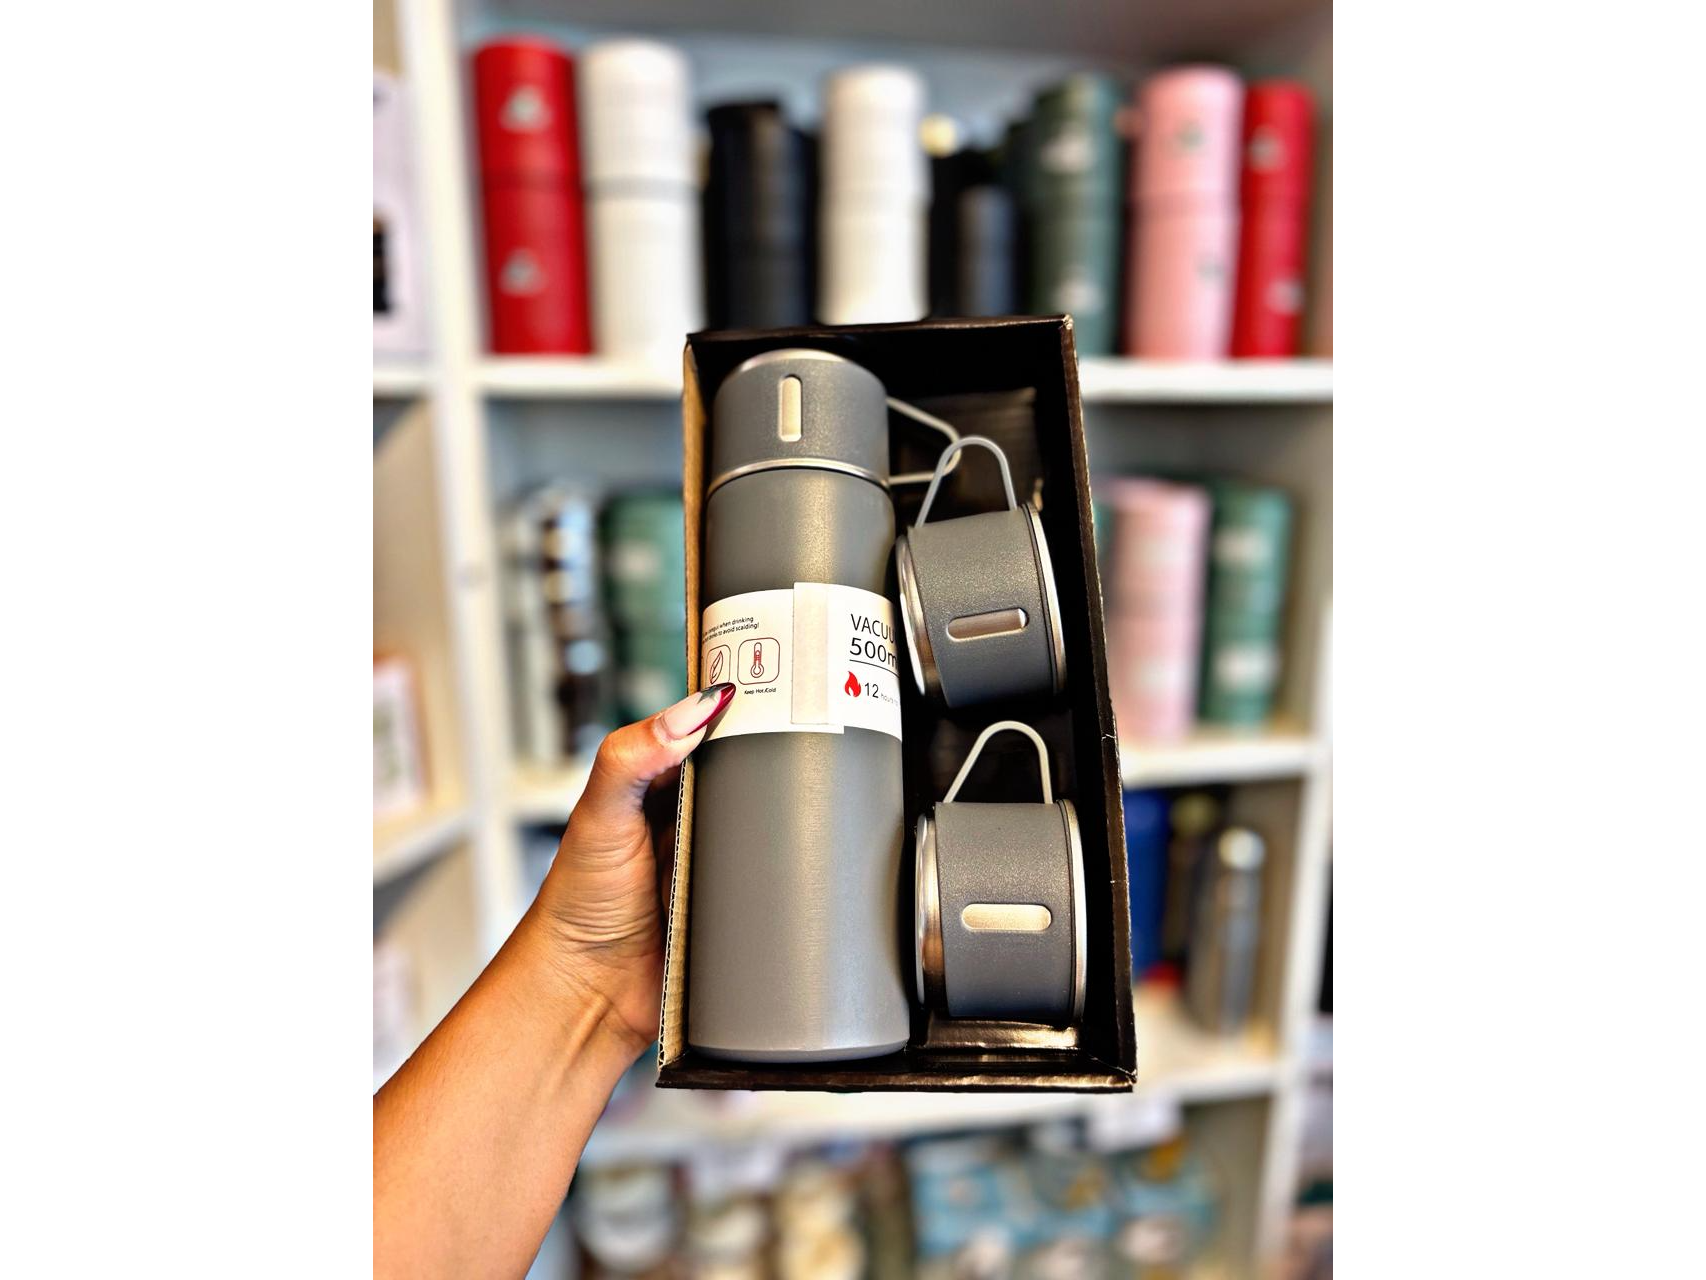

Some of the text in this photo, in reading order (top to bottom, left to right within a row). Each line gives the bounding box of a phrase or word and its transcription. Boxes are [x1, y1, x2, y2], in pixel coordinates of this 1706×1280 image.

[723, 626, 735, 635] avoid
[735, 621, 760, 631] scalding!
[732, 617, 754, 626] drinking
[864, 682, 879, 699] 12
